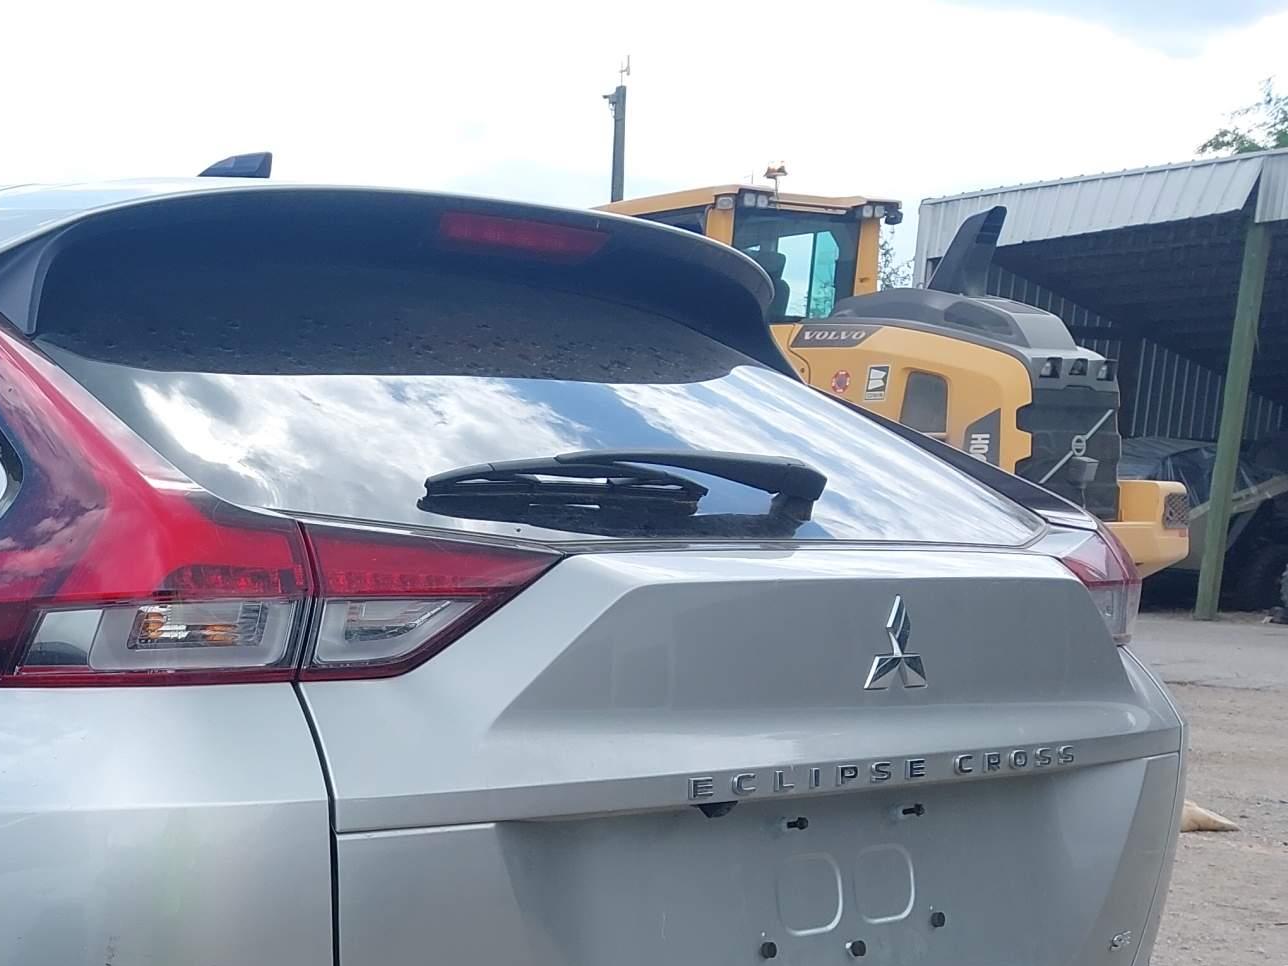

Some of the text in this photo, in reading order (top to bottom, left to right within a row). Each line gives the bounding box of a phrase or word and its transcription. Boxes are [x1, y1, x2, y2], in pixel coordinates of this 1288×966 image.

[804, 330, 866, 340] VOLVO
[688, 745, 1075, 800] ECLIPSE CROSS
